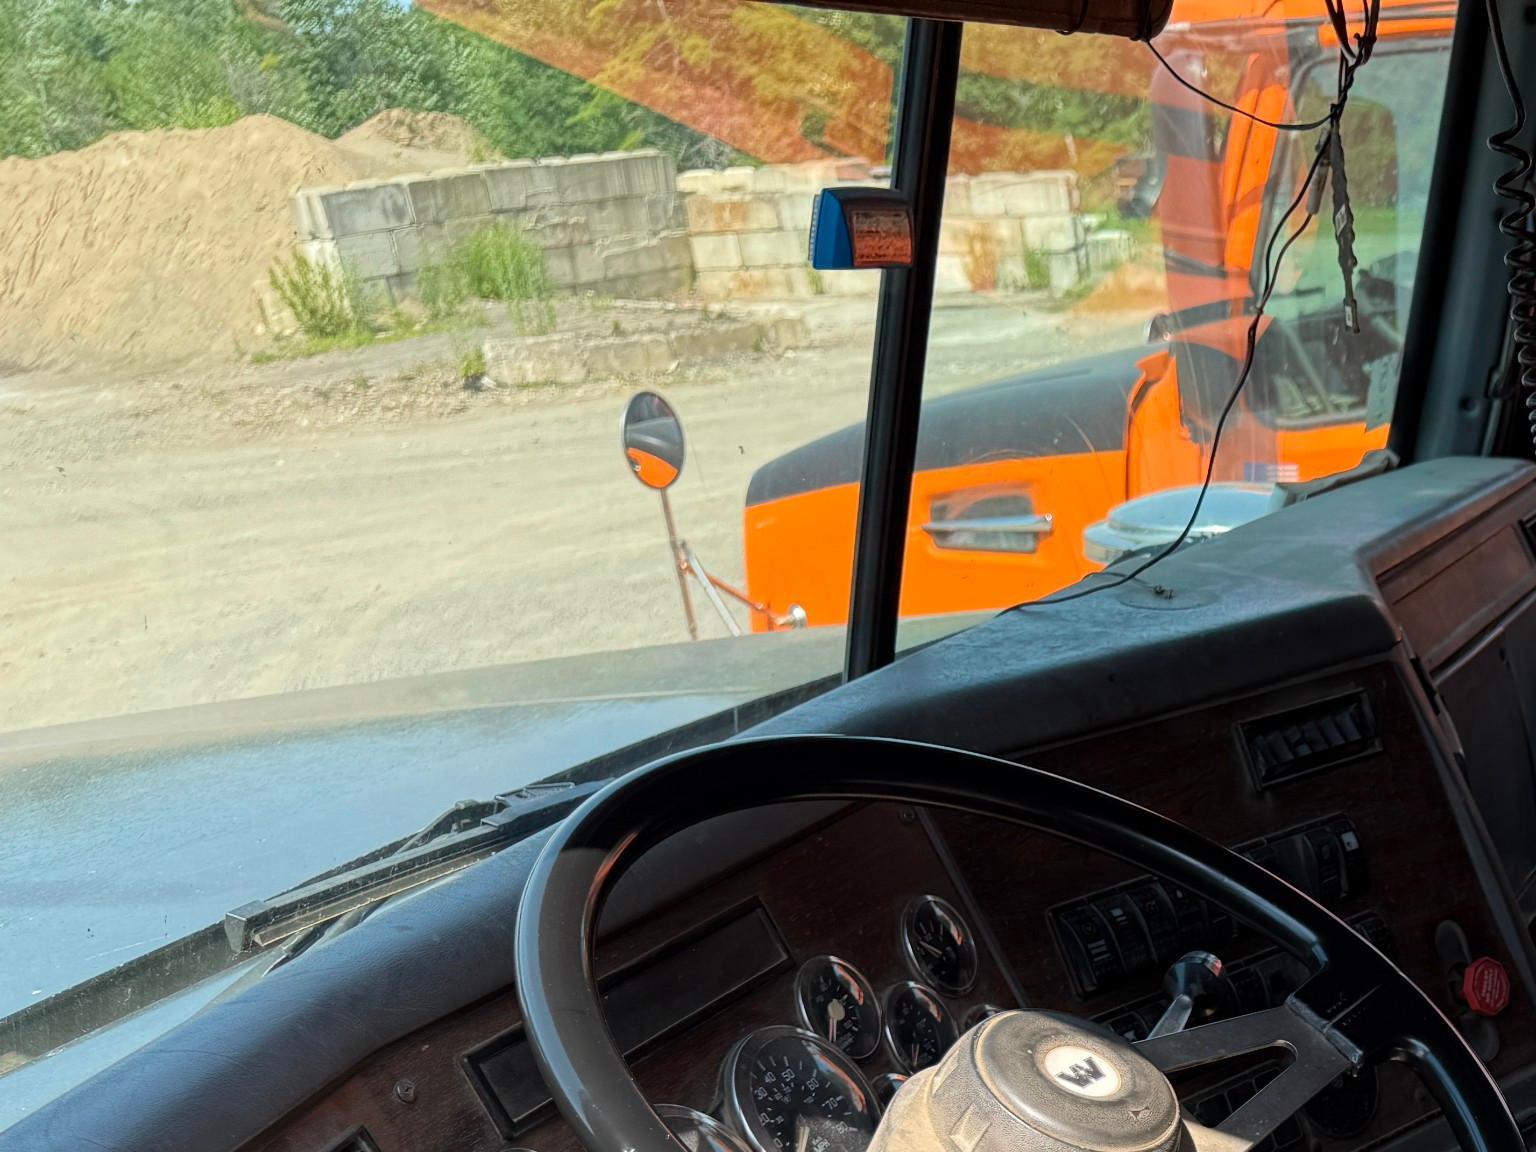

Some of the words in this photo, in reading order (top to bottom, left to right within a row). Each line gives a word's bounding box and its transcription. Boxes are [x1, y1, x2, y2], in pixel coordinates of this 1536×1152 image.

[764, 1071, 776, 1083] 40
[781, 1068, 795, 1082] 50
[806, 1079, 819, 1091] 60
[755, 1086, 768, 1100] 30
